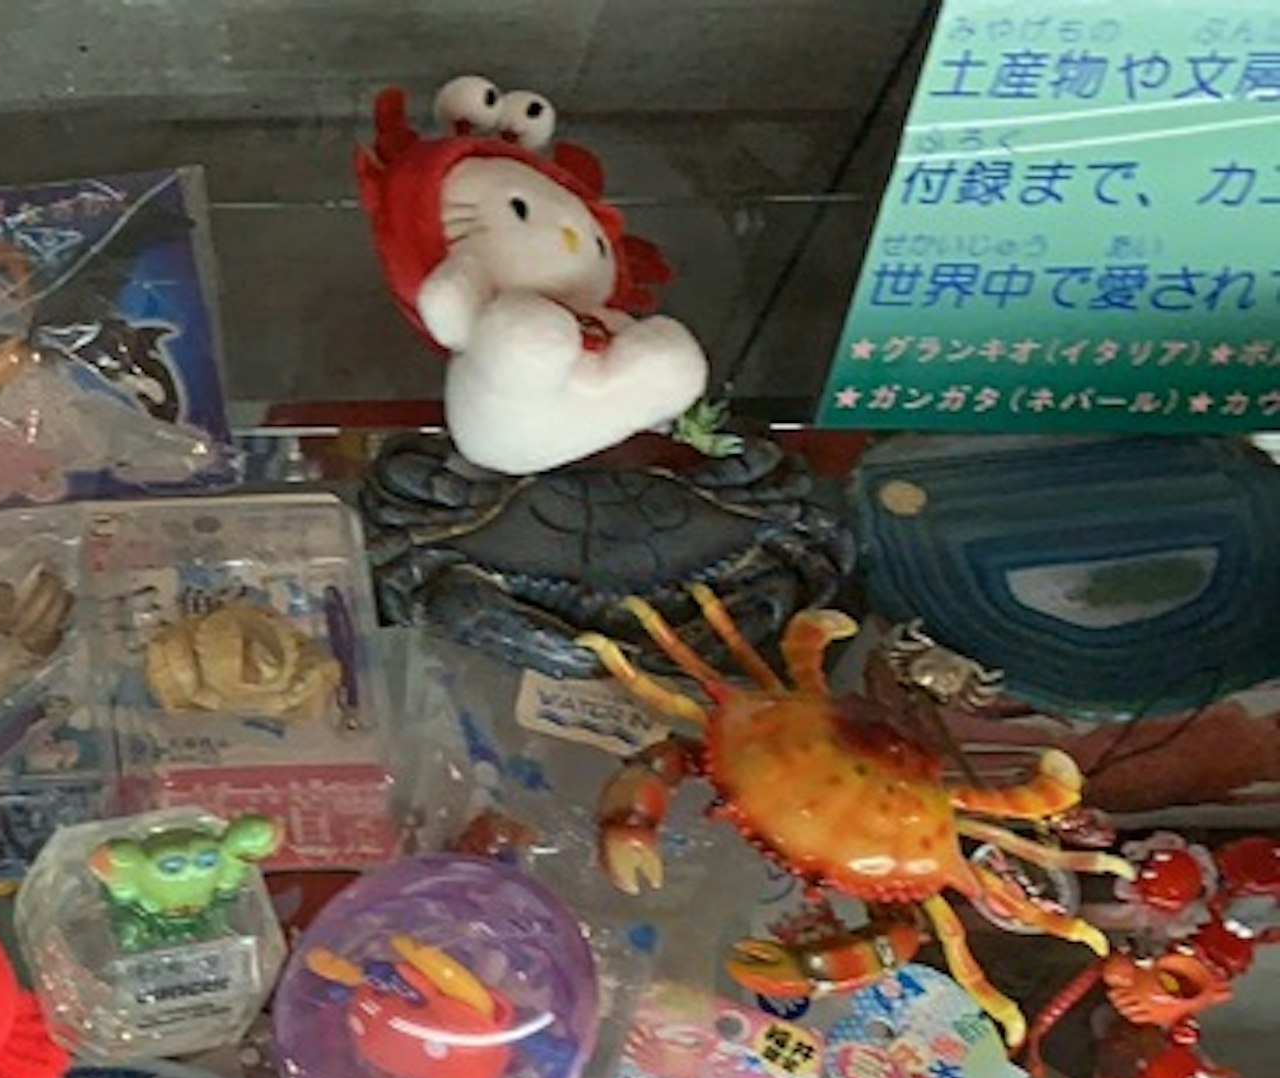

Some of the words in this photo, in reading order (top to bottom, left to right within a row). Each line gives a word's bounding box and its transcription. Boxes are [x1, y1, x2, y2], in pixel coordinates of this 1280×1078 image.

[868, 262, 1280, 311] 世界中で愛され
